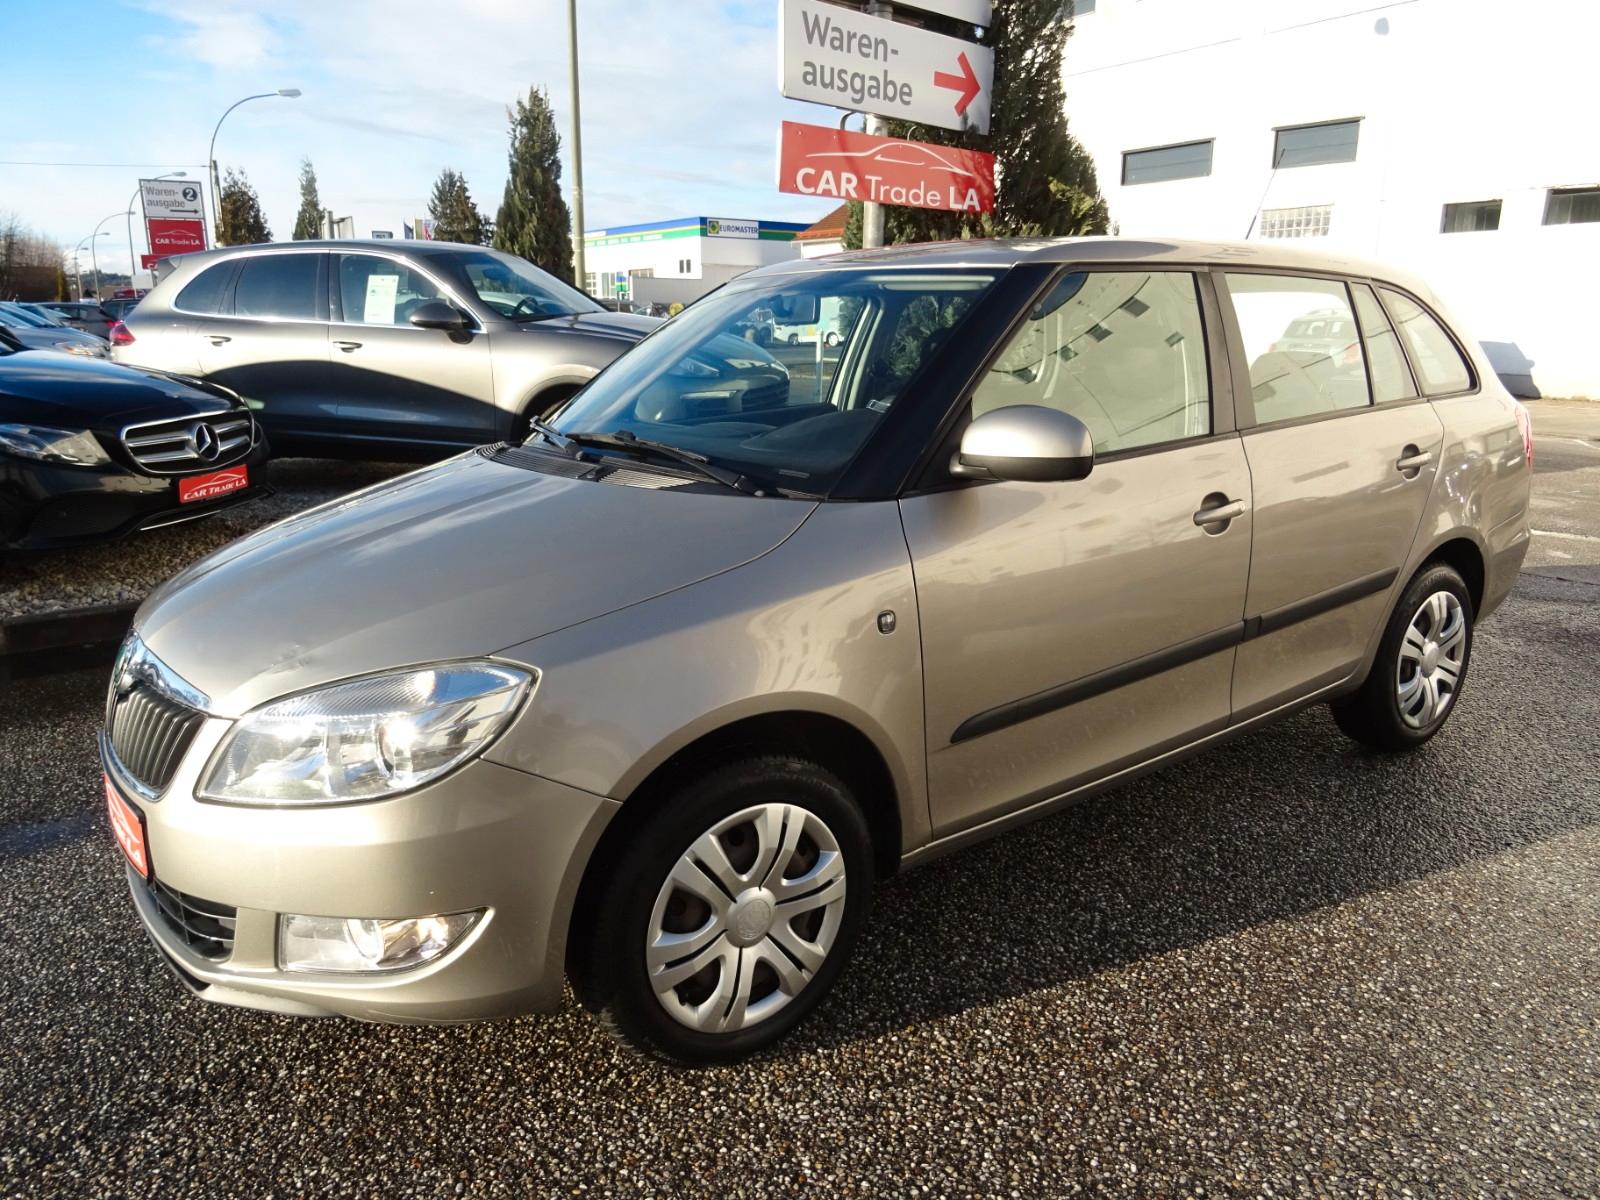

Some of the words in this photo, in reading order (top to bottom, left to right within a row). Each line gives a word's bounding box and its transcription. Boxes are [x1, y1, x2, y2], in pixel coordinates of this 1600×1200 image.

[802, 11, 899, 62] Waren-
[802, 60, 913, 106] ausgabe
[145, 186, 179, 196] Waren-
[796, 167, 858, 199] CAR
[865, 175, 941, 206] Trade
[949, 186, 981, 211] LA
[146, 200, 186, 209] ausgabe
[719, 224, 758, 234] EUROMASTER
[183, 489, 207, 500] CAR
[235, 478, 246, 487] LA
